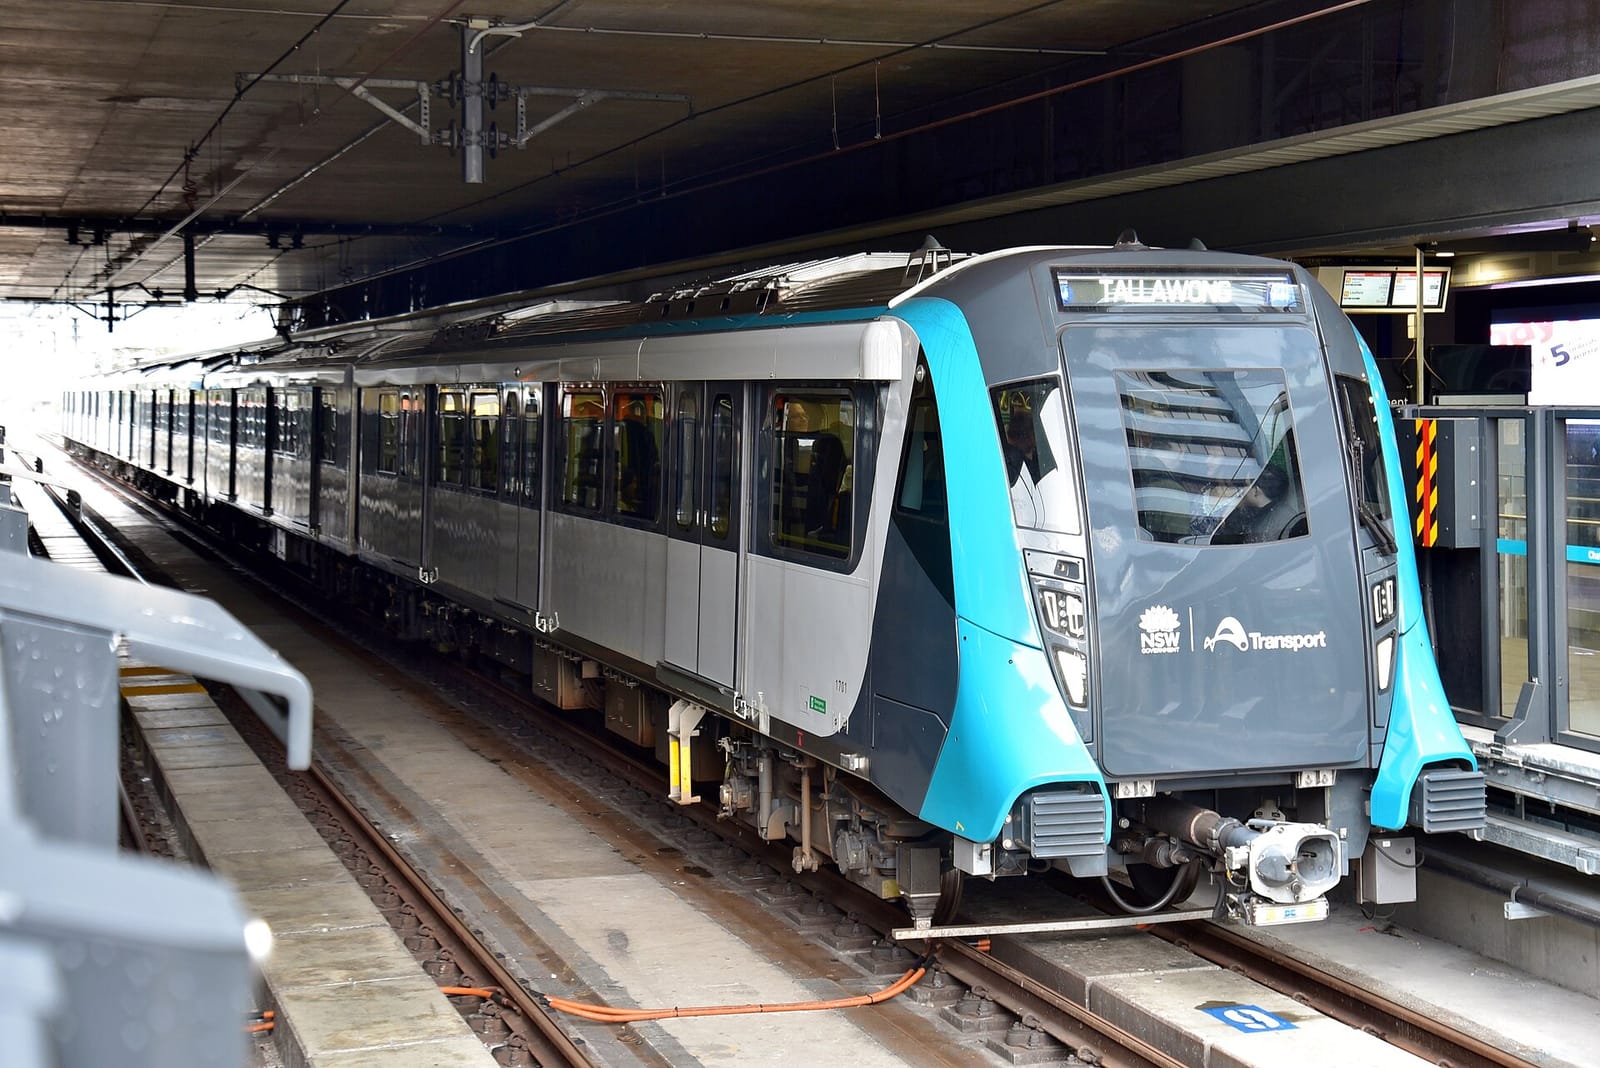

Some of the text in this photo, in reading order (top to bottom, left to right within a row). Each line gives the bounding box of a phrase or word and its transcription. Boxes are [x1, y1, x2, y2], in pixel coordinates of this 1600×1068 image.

[1099, 279, 1233, 303] TALLAWONG
[1550, 344, 1570, 367] 5
[1141, 631, 1180, 648] NSW
[1249, 631, 1327, 652] Transport
